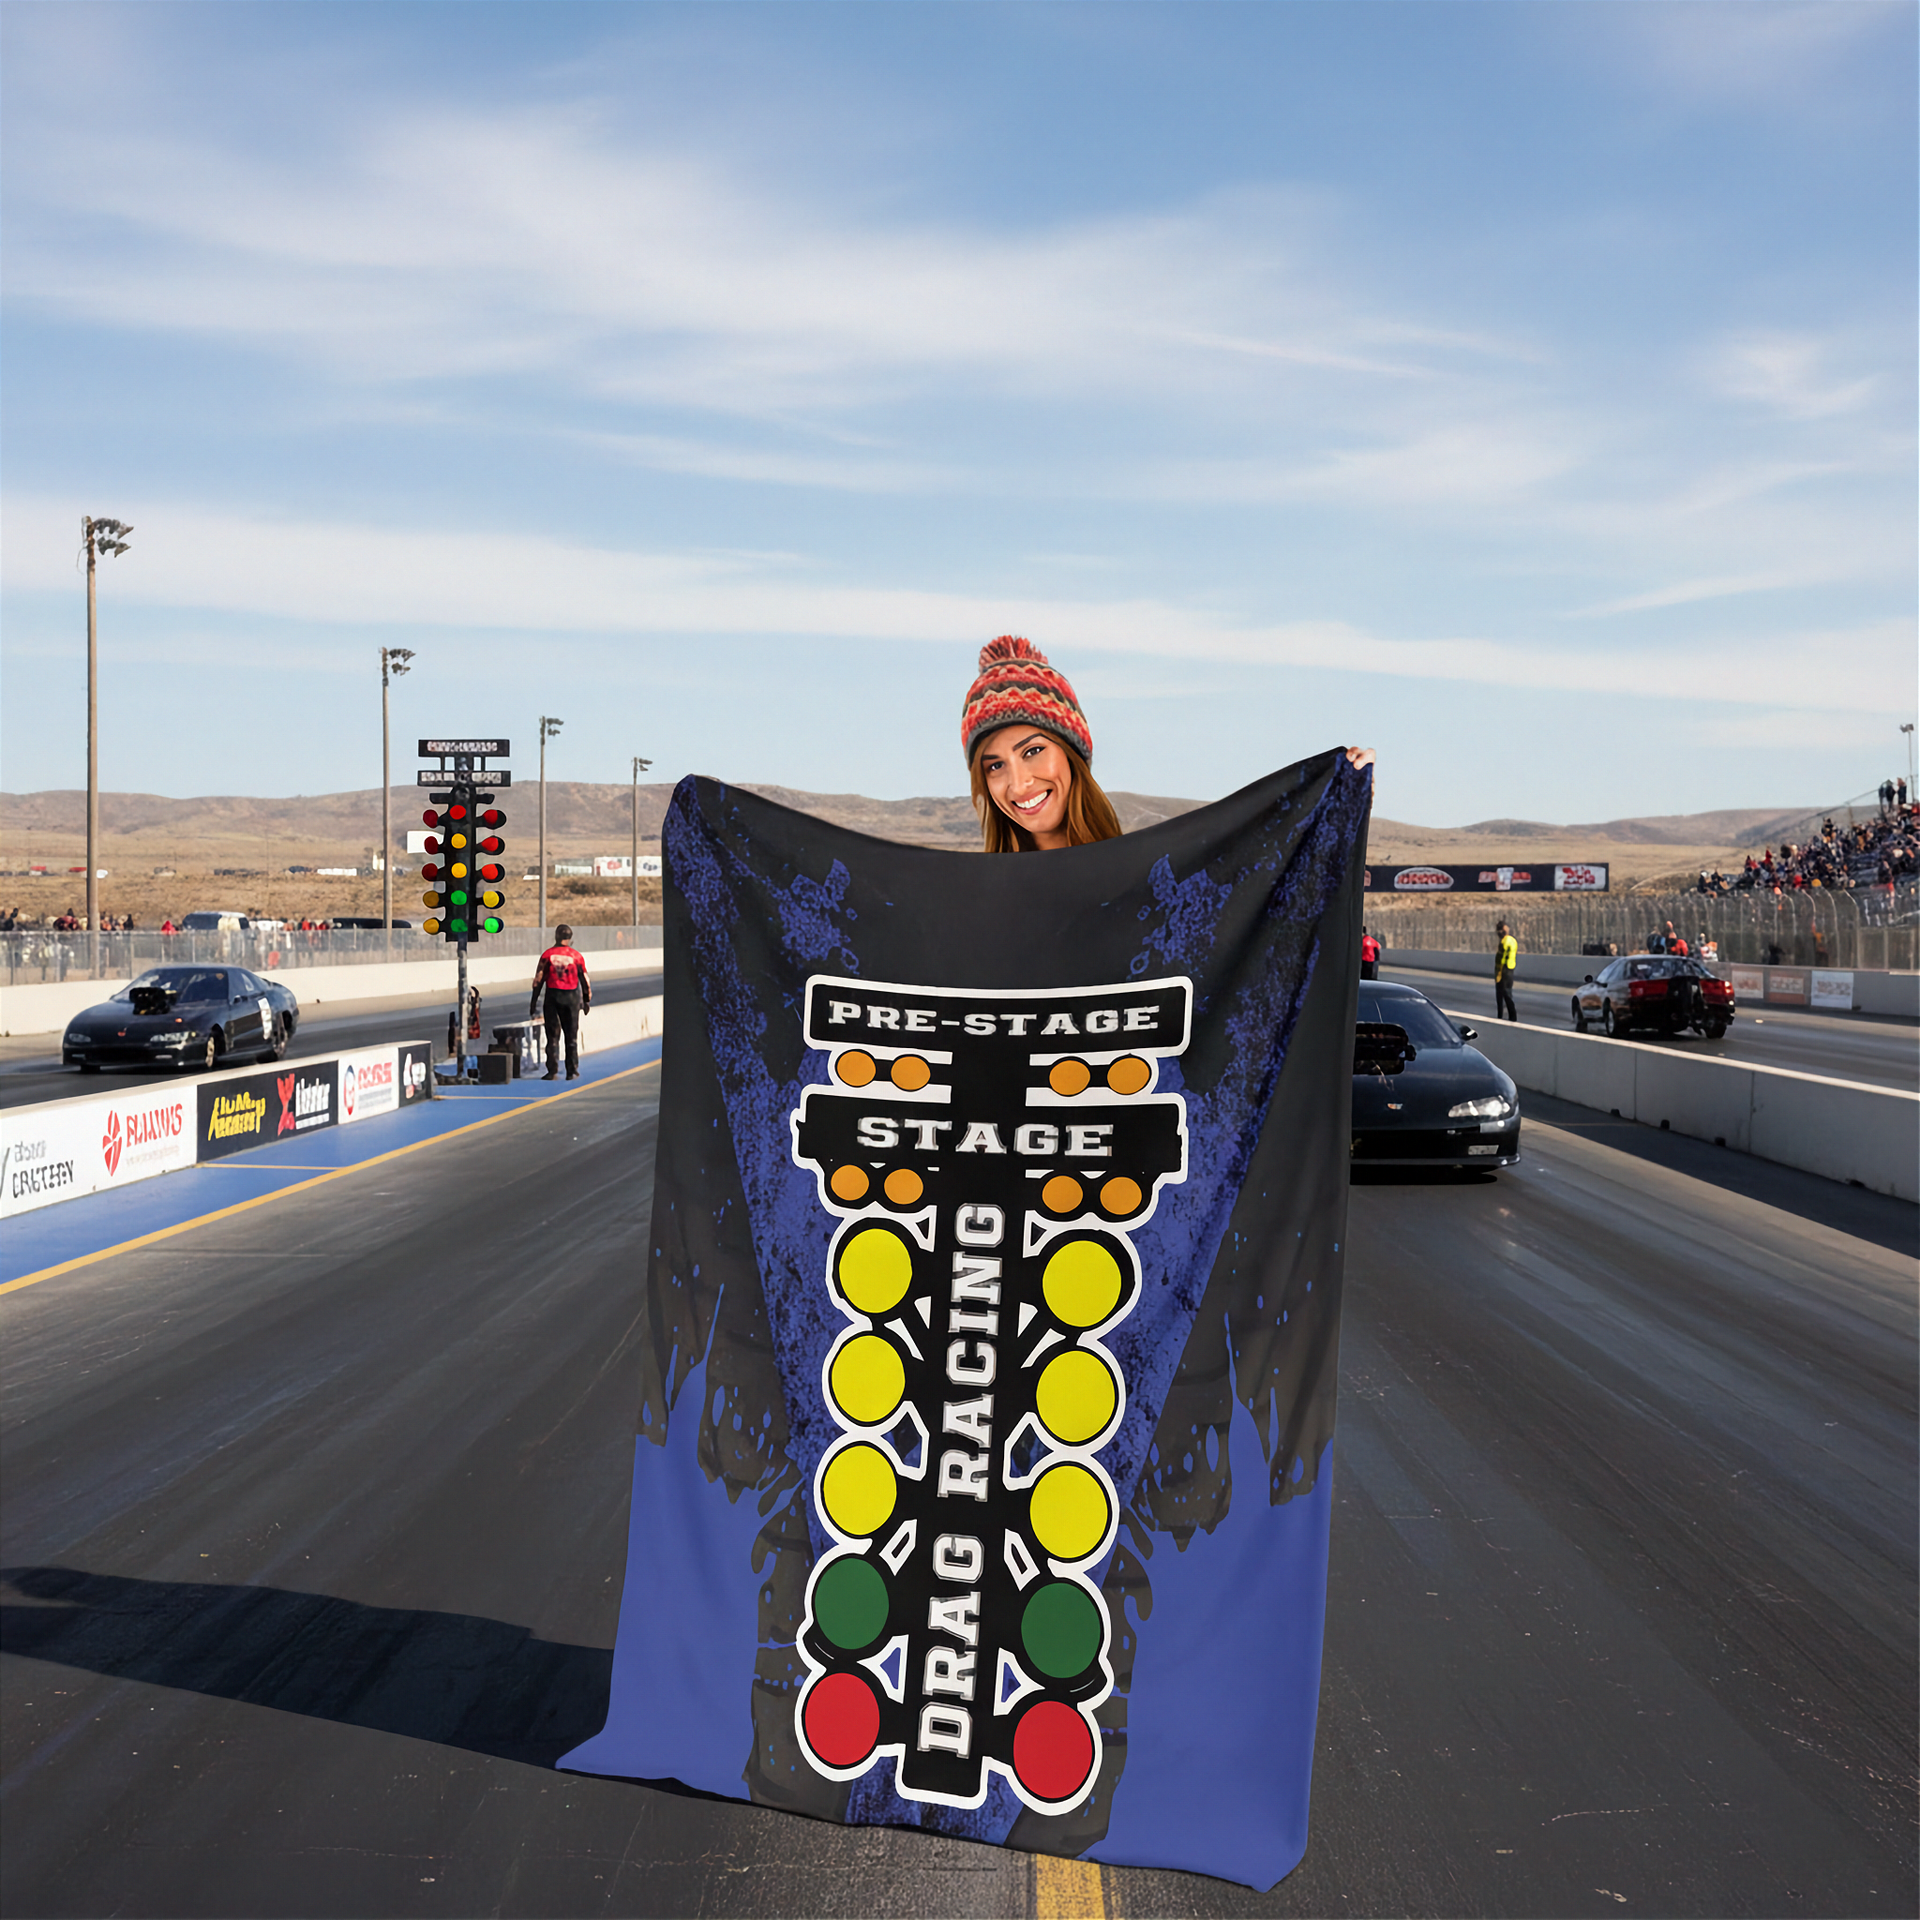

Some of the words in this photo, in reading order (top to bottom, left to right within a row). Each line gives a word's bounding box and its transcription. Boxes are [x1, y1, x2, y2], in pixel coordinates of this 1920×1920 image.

[828, 1001, 1160, 1036] PRE-STAGE
[857, 1117, 1113, 1156] STAGE
[936, 1203, 1006, 1502] RACING
[917, 1534, 984, 1758] DRAG
